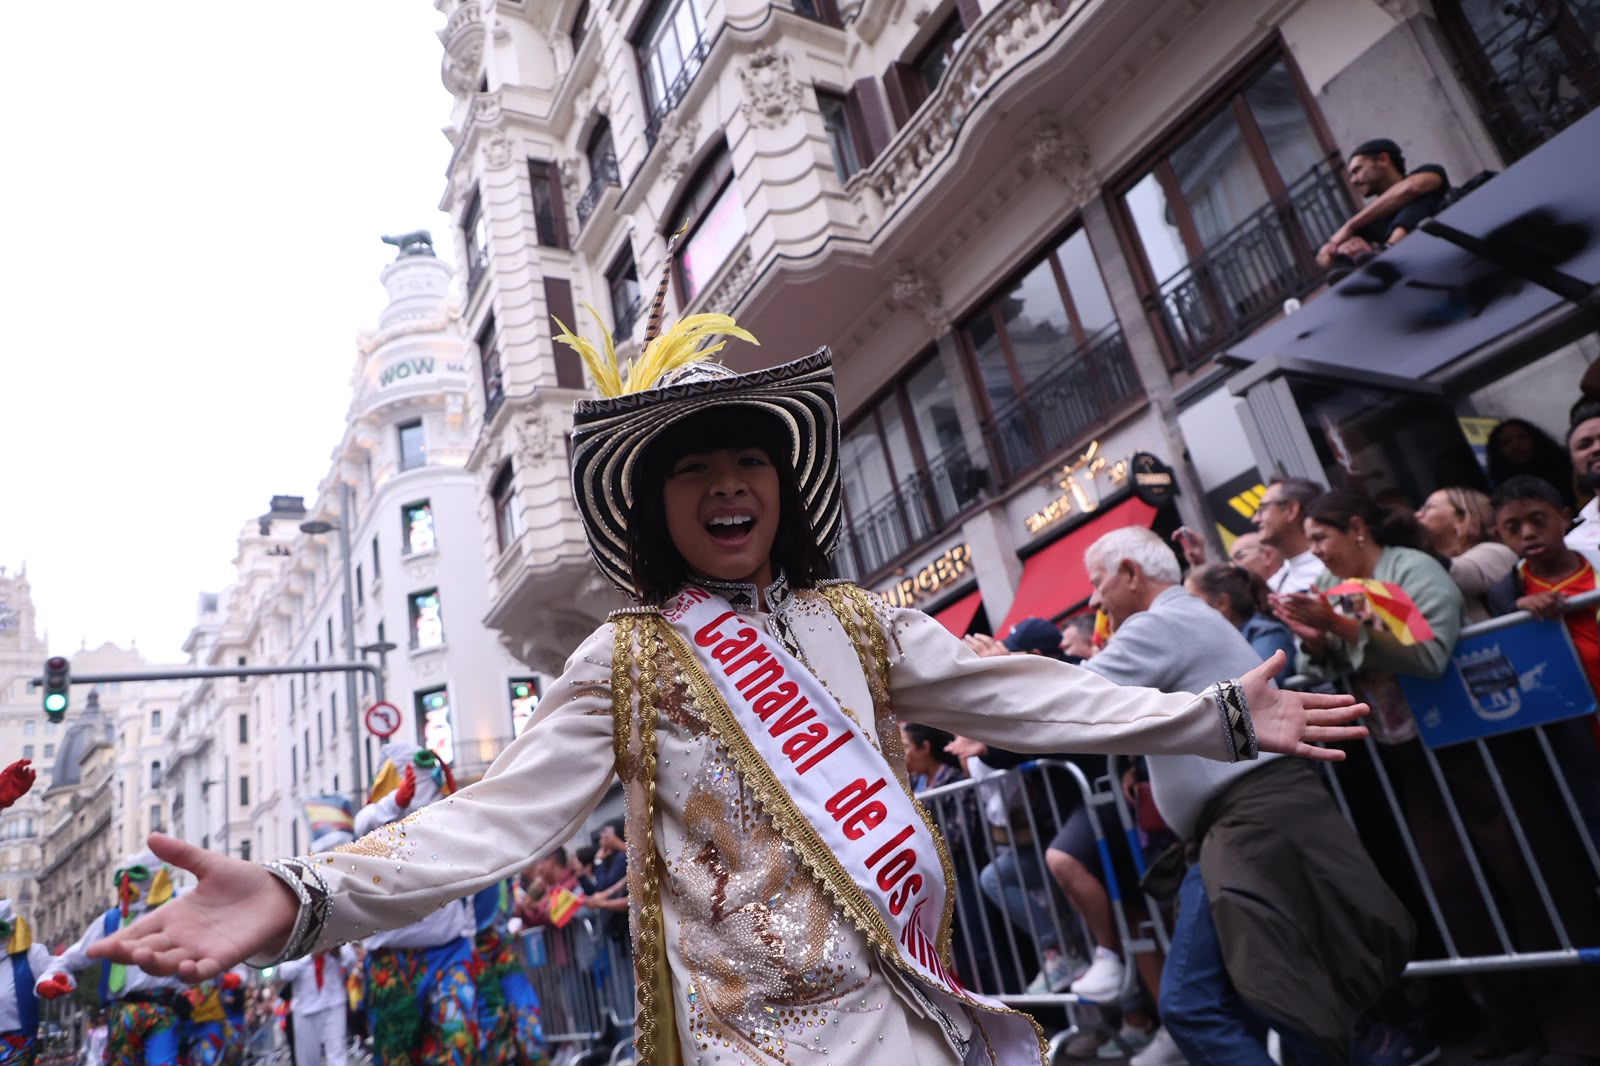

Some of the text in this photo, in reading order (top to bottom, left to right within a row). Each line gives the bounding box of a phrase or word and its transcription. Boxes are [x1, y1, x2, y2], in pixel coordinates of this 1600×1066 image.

[379, 356, 435, 388] WOW
[880, 542, 972, 609] URGER
[694, 610, 923, 917] Carnaval de los
